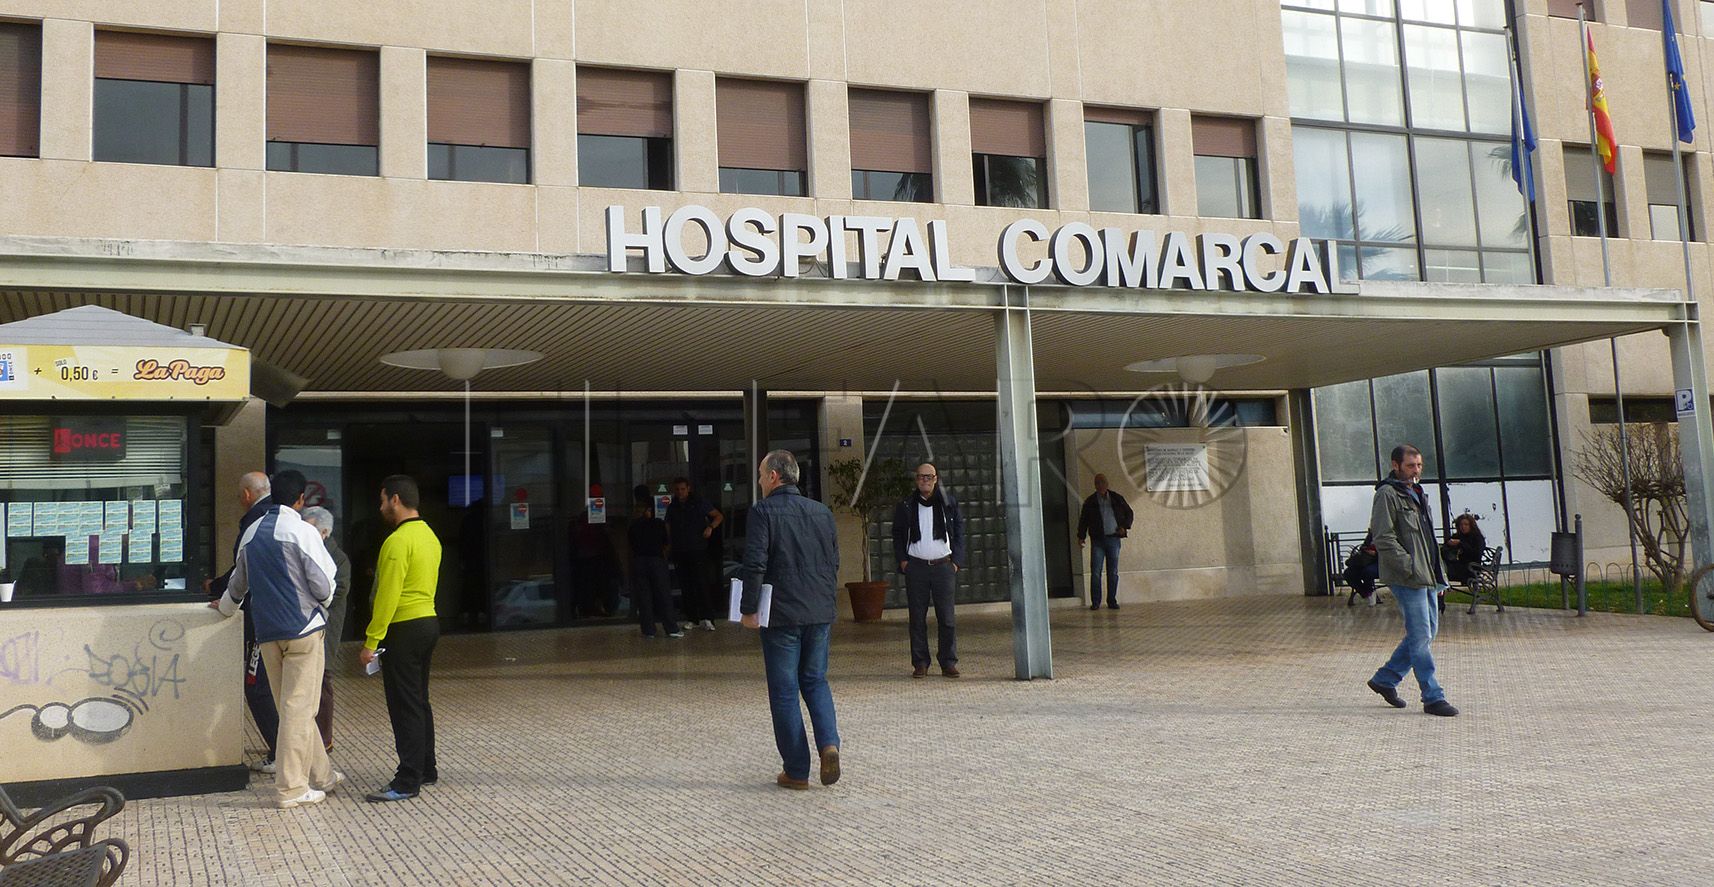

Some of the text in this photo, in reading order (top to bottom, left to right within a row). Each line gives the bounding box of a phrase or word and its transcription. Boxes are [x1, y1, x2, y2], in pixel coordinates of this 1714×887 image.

[606, 204, 1360, 295] HOSPITAL COMARCAL
[61, 366, 89, 382] 0,50
[168, 359, 225, 385] Paga
